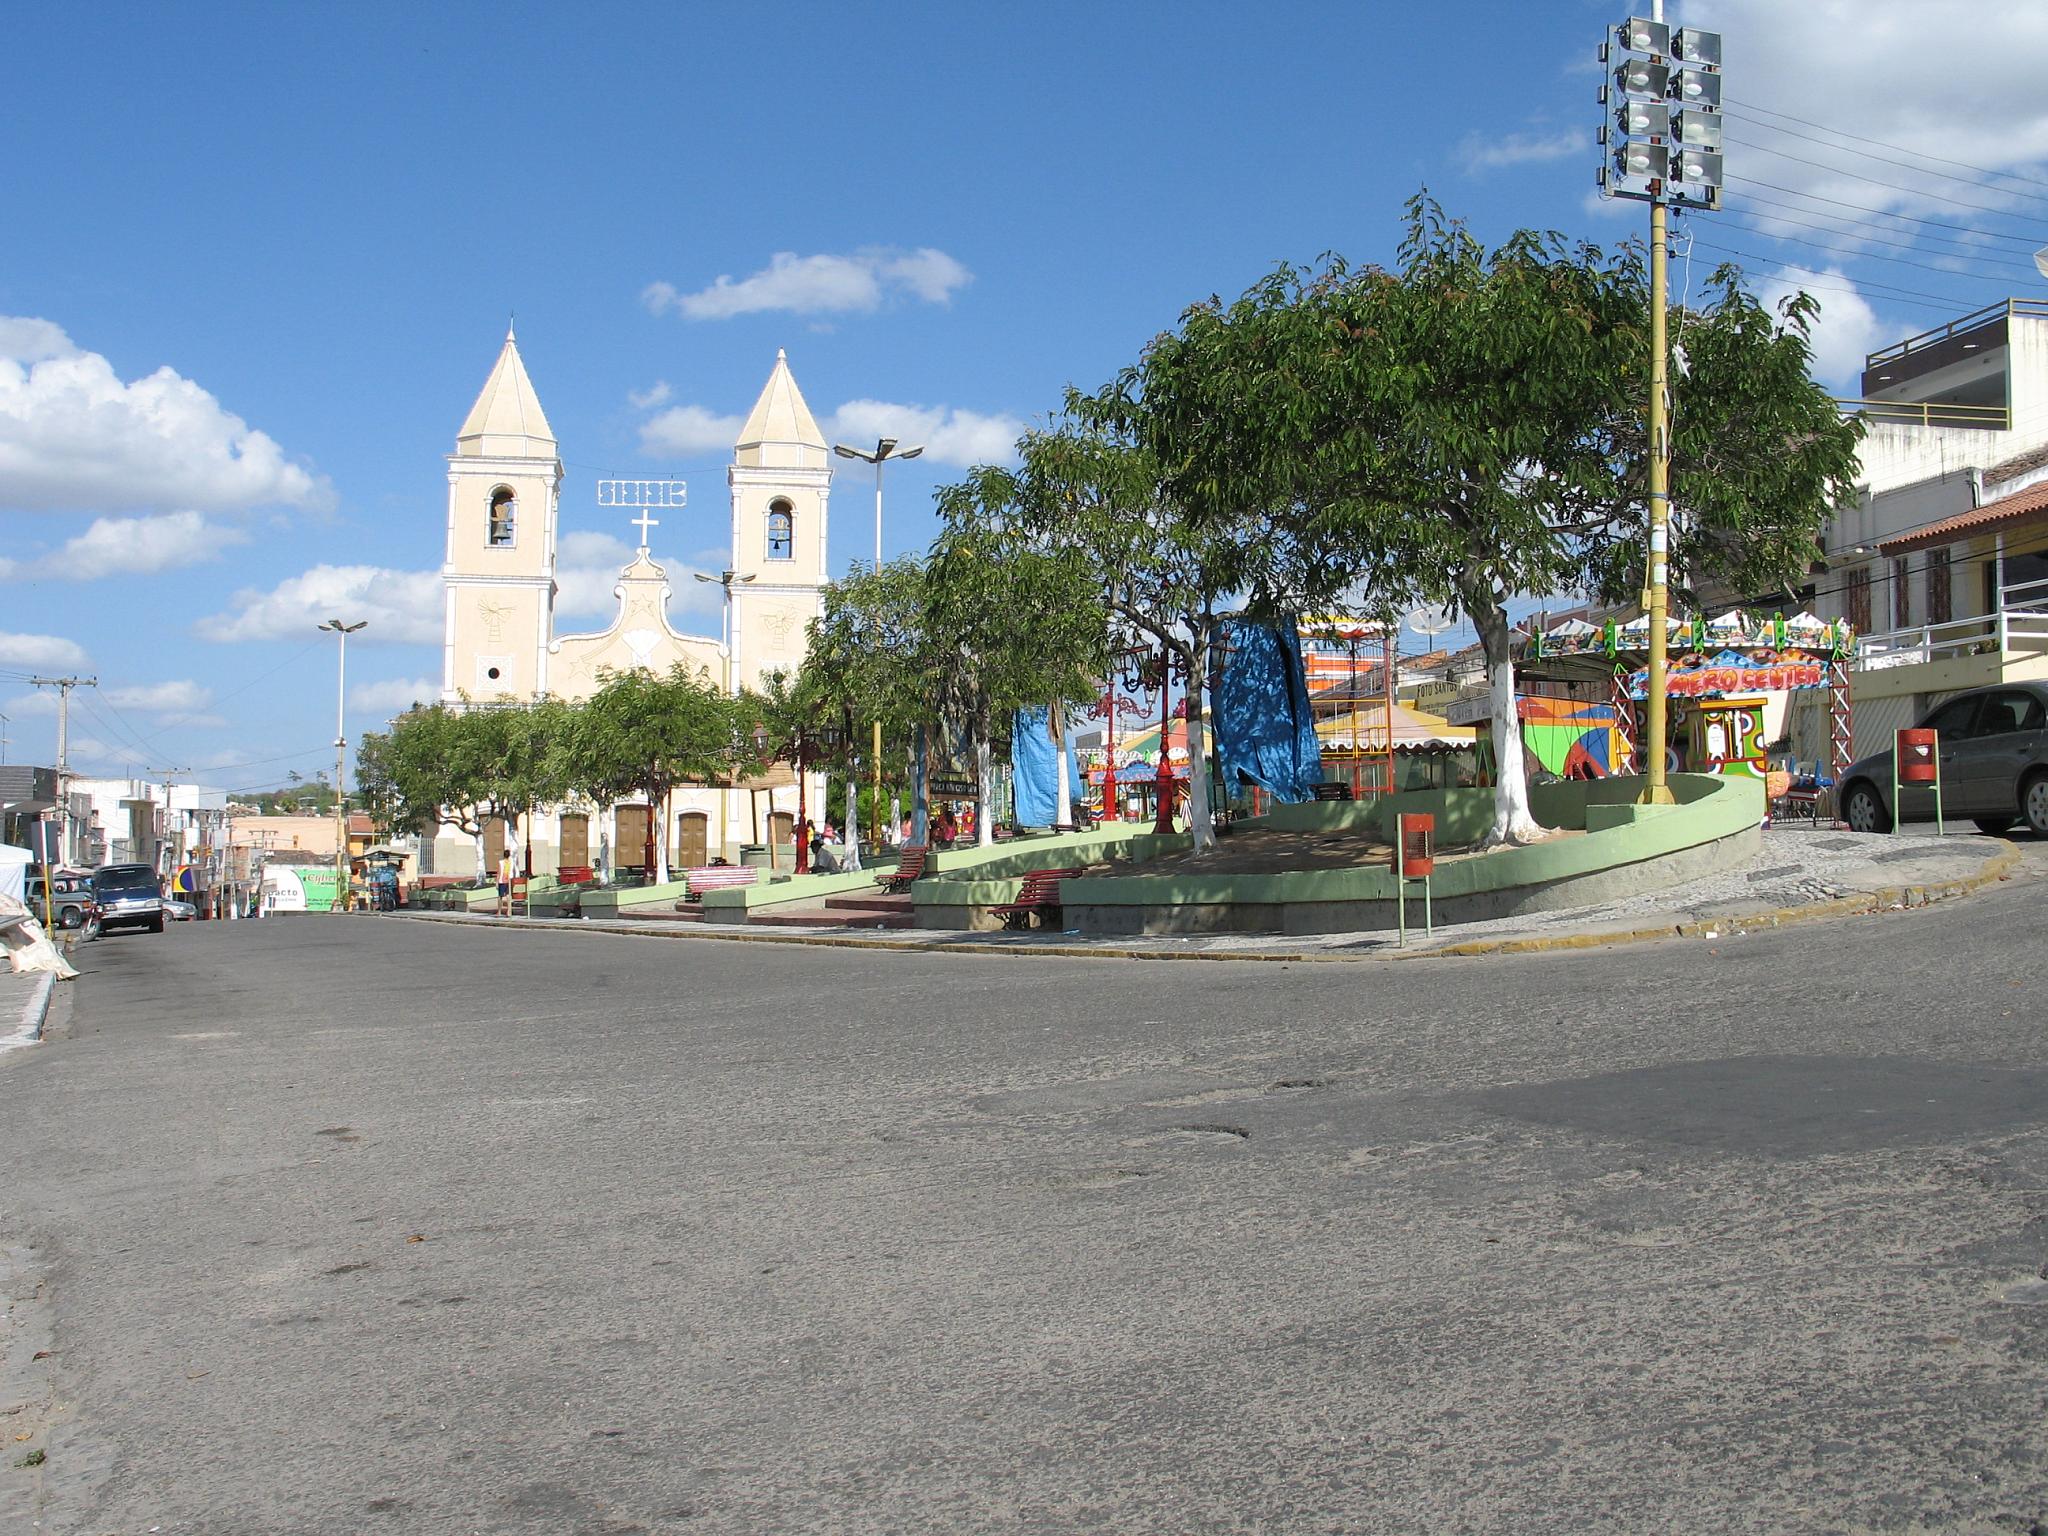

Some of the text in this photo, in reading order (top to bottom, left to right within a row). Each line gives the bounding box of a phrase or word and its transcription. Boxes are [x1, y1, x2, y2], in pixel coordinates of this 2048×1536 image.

[1741, 664, 1820, 687] CENTER
[1417, 682, 1457, 697] FOTO SANTOS
